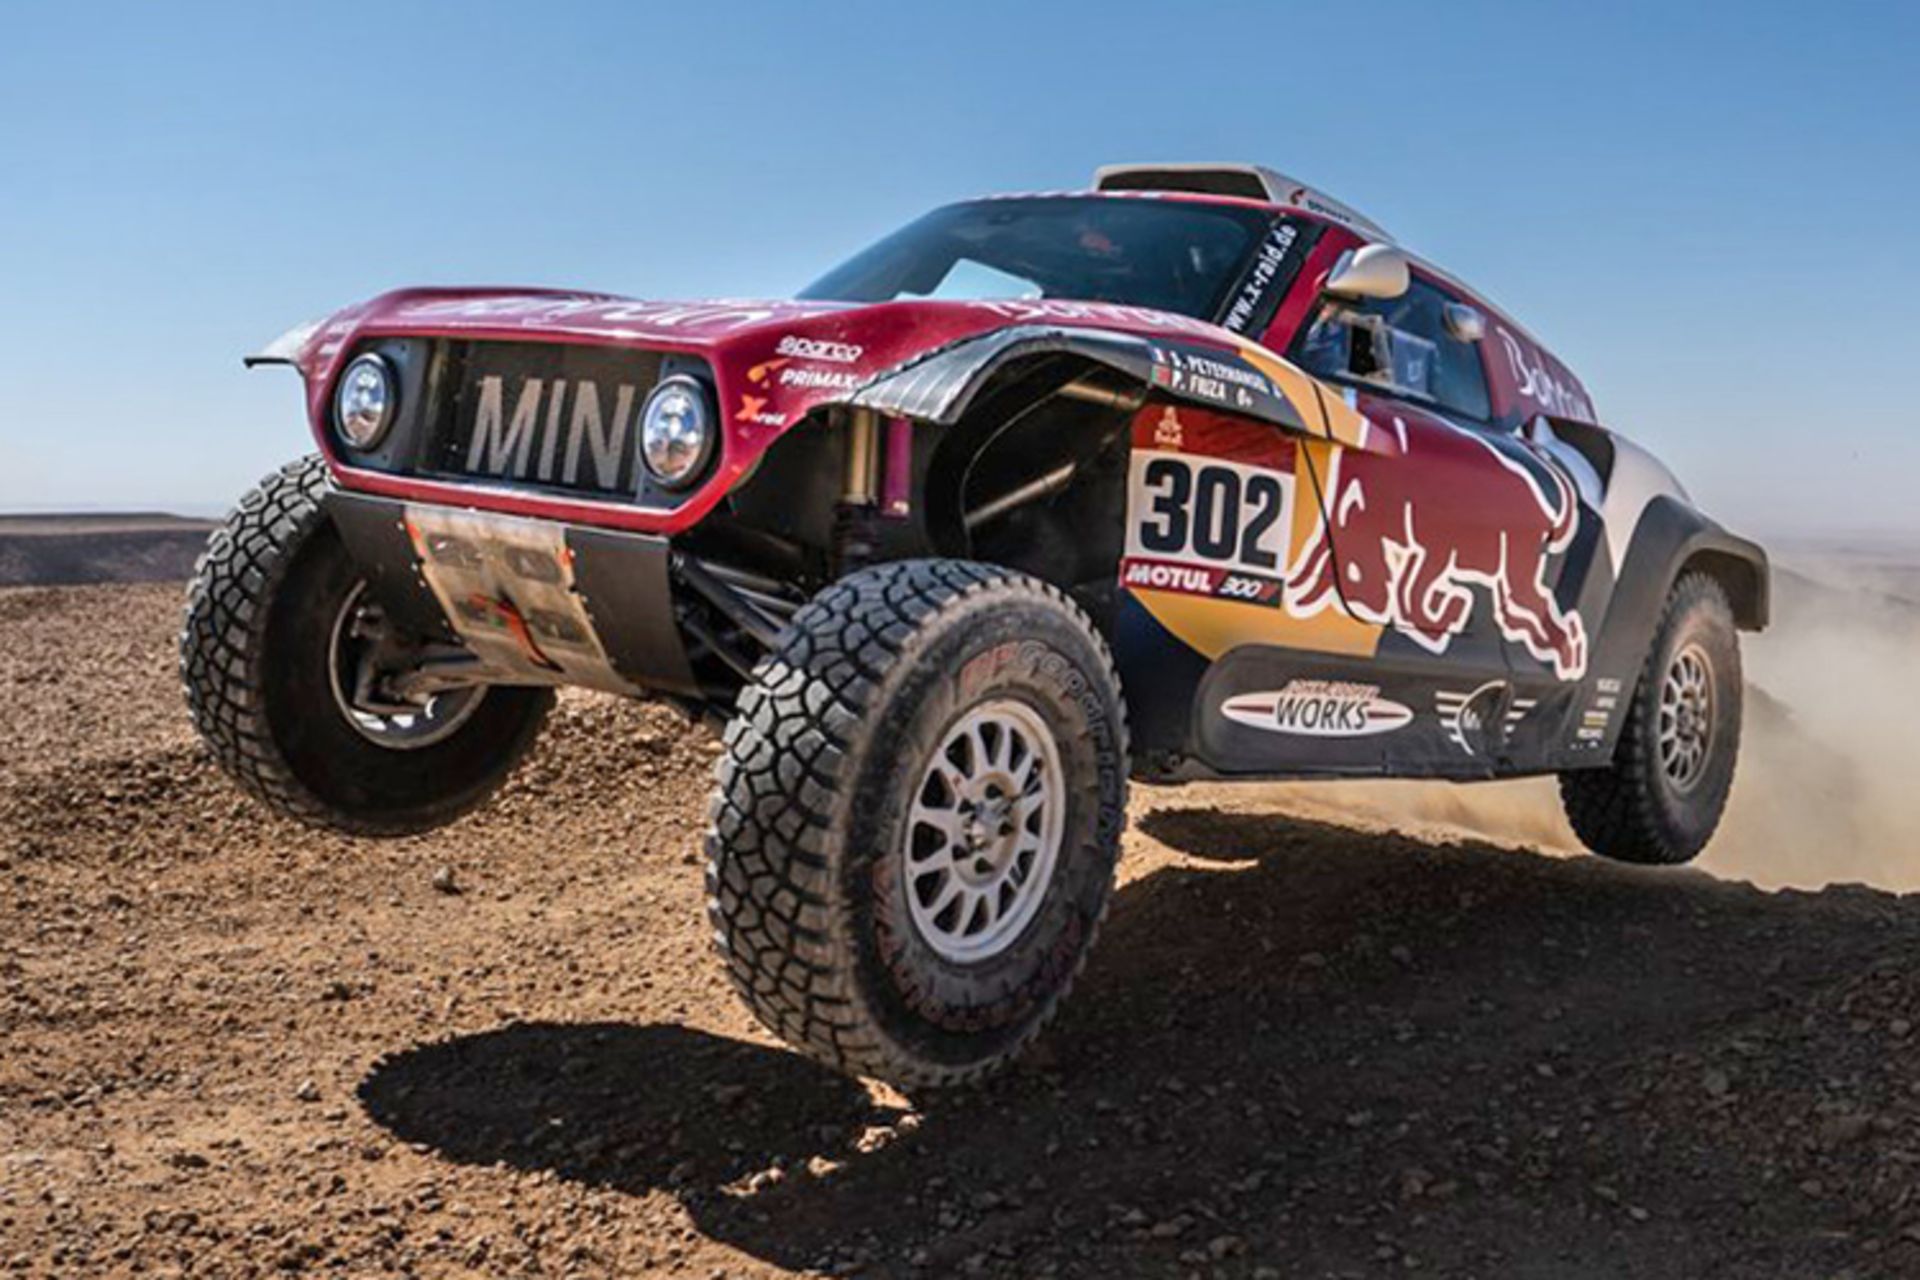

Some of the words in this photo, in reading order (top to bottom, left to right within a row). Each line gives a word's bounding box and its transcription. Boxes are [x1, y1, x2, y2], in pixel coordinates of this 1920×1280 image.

[1222, 223, 1298, 332] ww.x-raid.de
[465, 376, 637, 492] MIN
[1139, 457, 1284, 570] 302
[1125, 563, 1213, 593] MOTUL
[1277, 697, 1371, 730] WORKS
